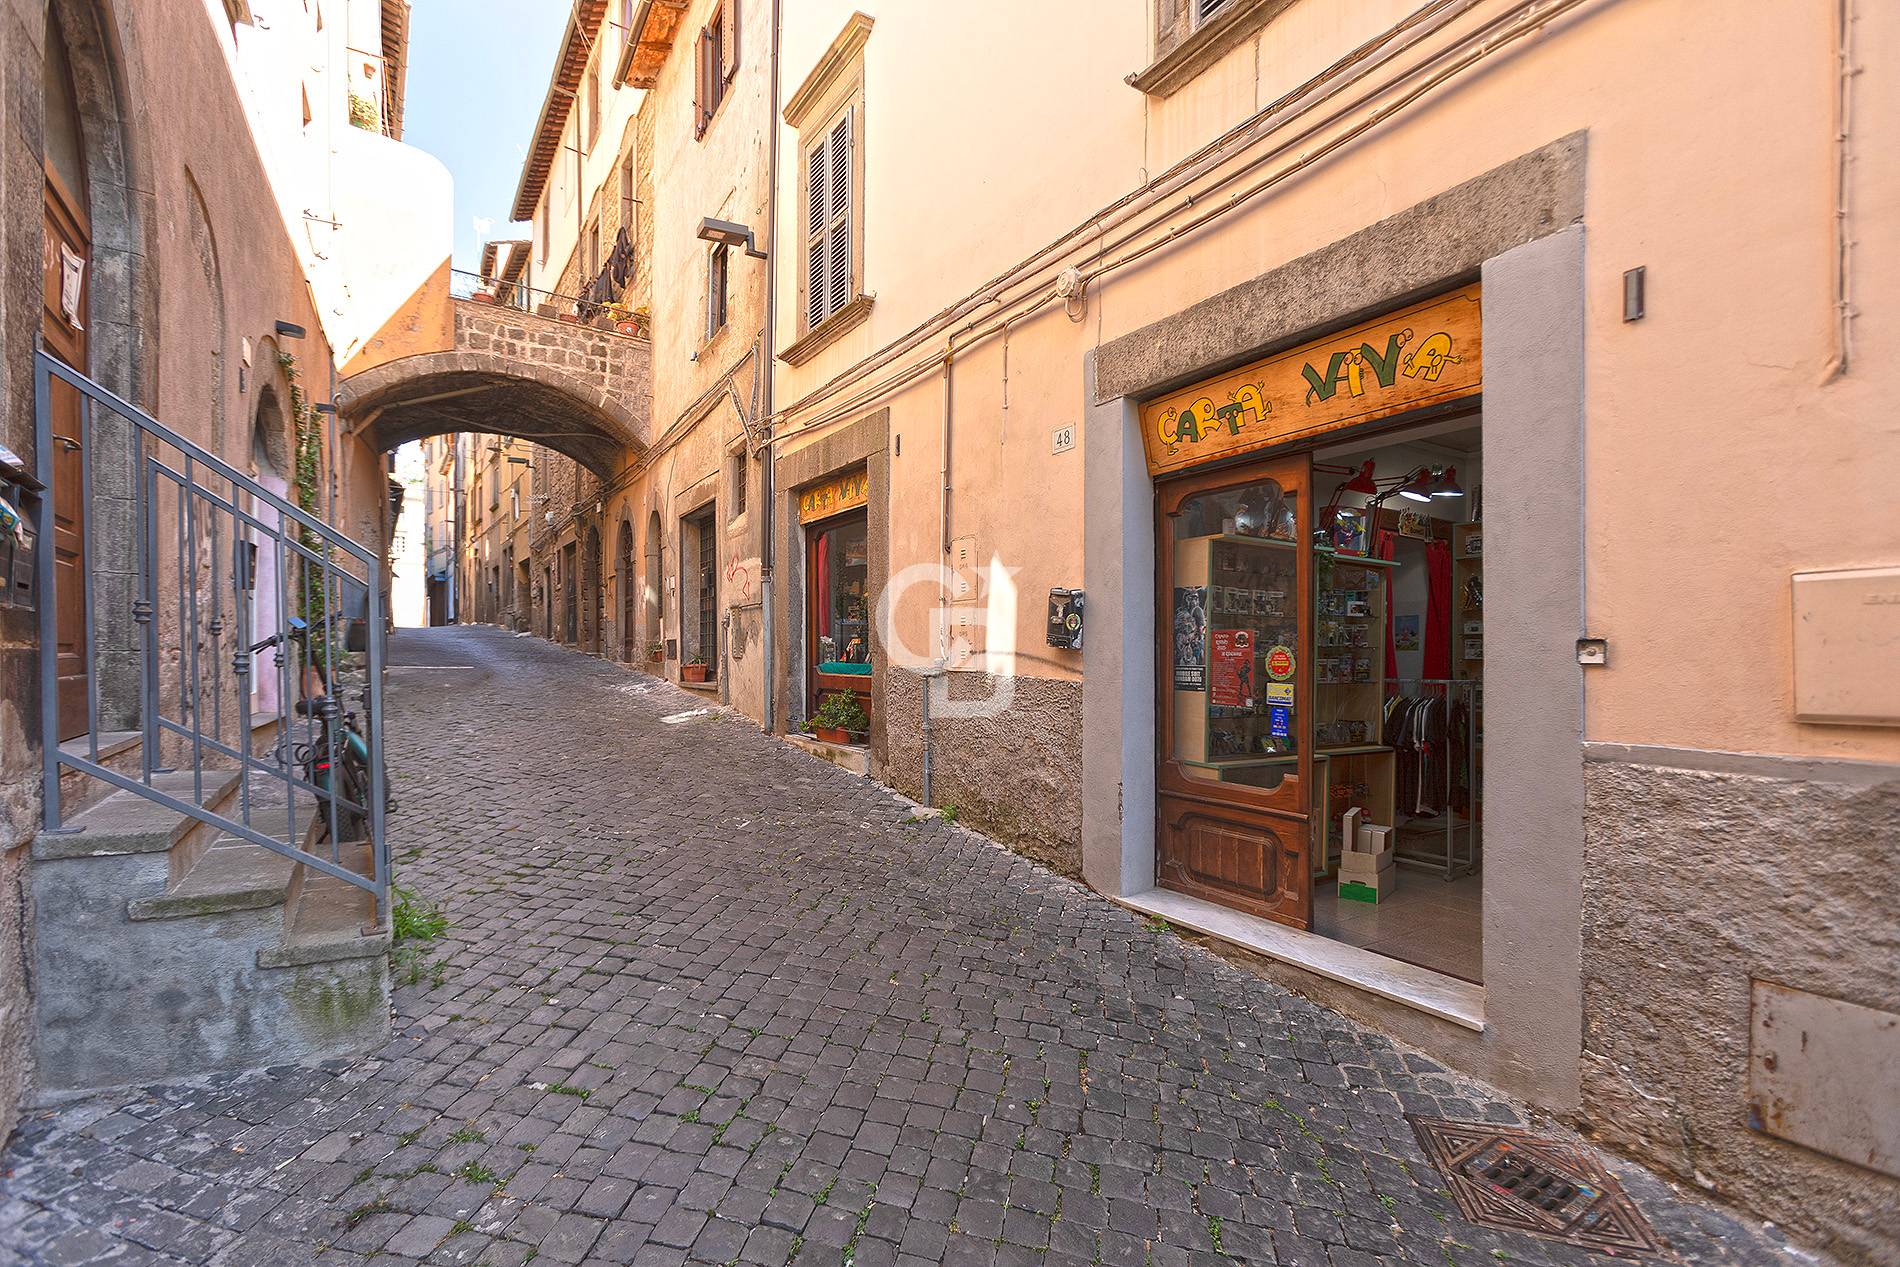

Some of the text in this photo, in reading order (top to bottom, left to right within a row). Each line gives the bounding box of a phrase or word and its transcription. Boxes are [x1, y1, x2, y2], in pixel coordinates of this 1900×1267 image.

[1156, 327, 1463, 456] CARTA VIVA
[1056, 429, 1071, 447] 48
[803, 486, 834, 512] CARTA
